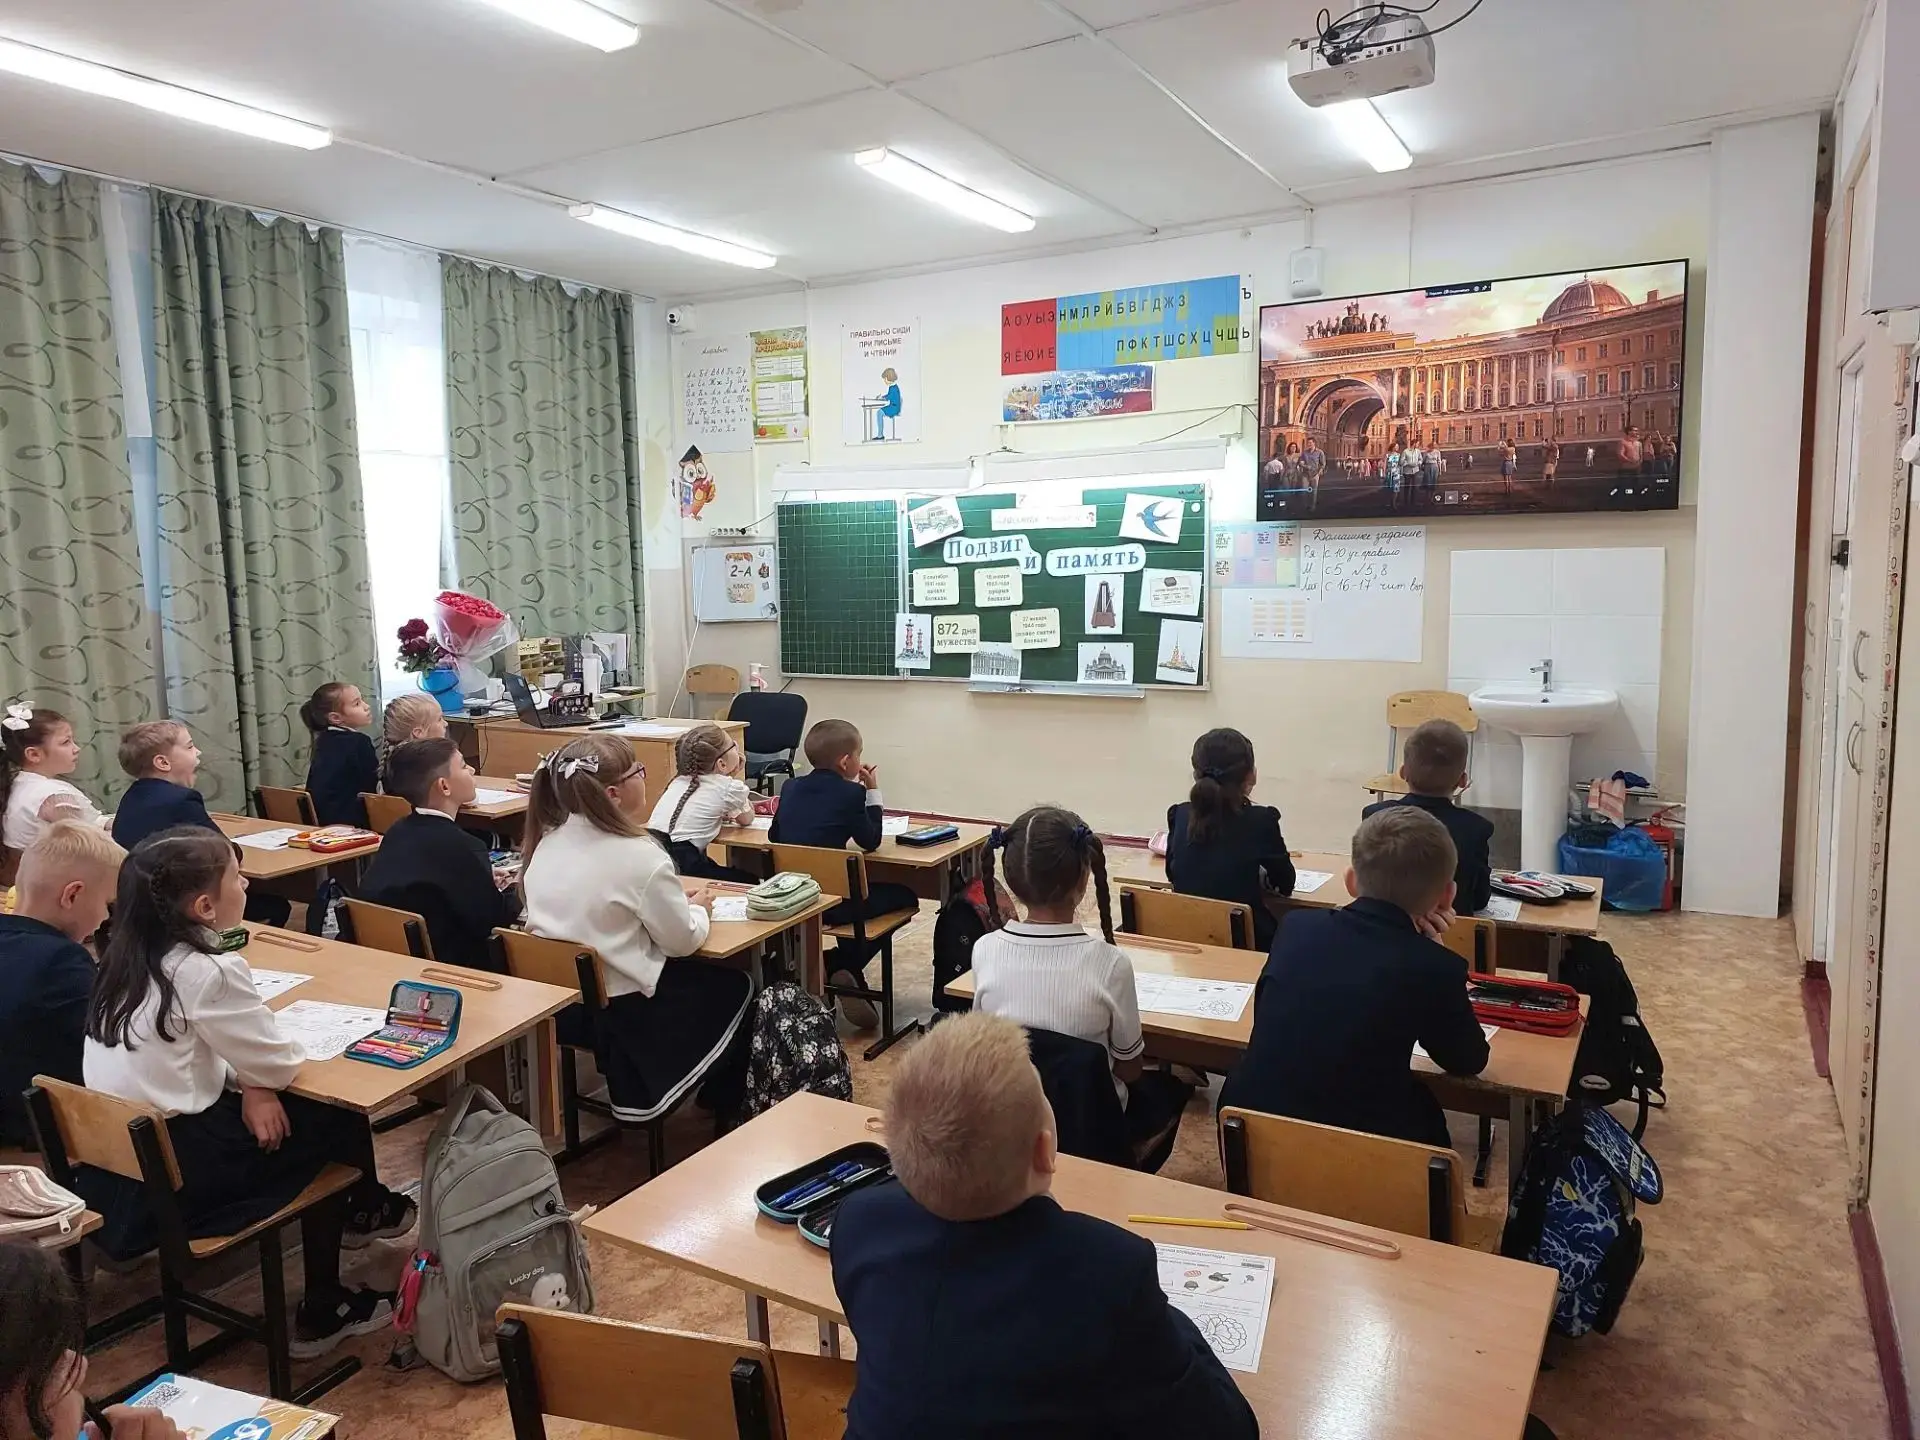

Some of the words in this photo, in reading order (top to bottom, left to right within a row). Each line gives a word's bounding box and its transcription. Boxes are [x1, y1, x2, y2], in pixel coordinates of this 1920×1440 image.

[850, 328, 890, 338] ПРАВИЛЬНО
[892, 325, 911, 334] СИДИ
[859, 340, 873, 348] ПРИ
[874, 338, 902, 346] ПИСЬМЕ
[870, 348, 897, 357] ЧТЕНИИ
[948, 537, 1024, 559] Подвиг
[1025, 556, 1037, 569] и
[1057, 550, 1139, 569] память
[937, 623, 959, 635] 872
[961, 628, 977, 636] дня
[936, 639, 977, 648] мужества
[509, 1271, 532, 1286] Lucky
[531, 1265, 545, 1278] dog
